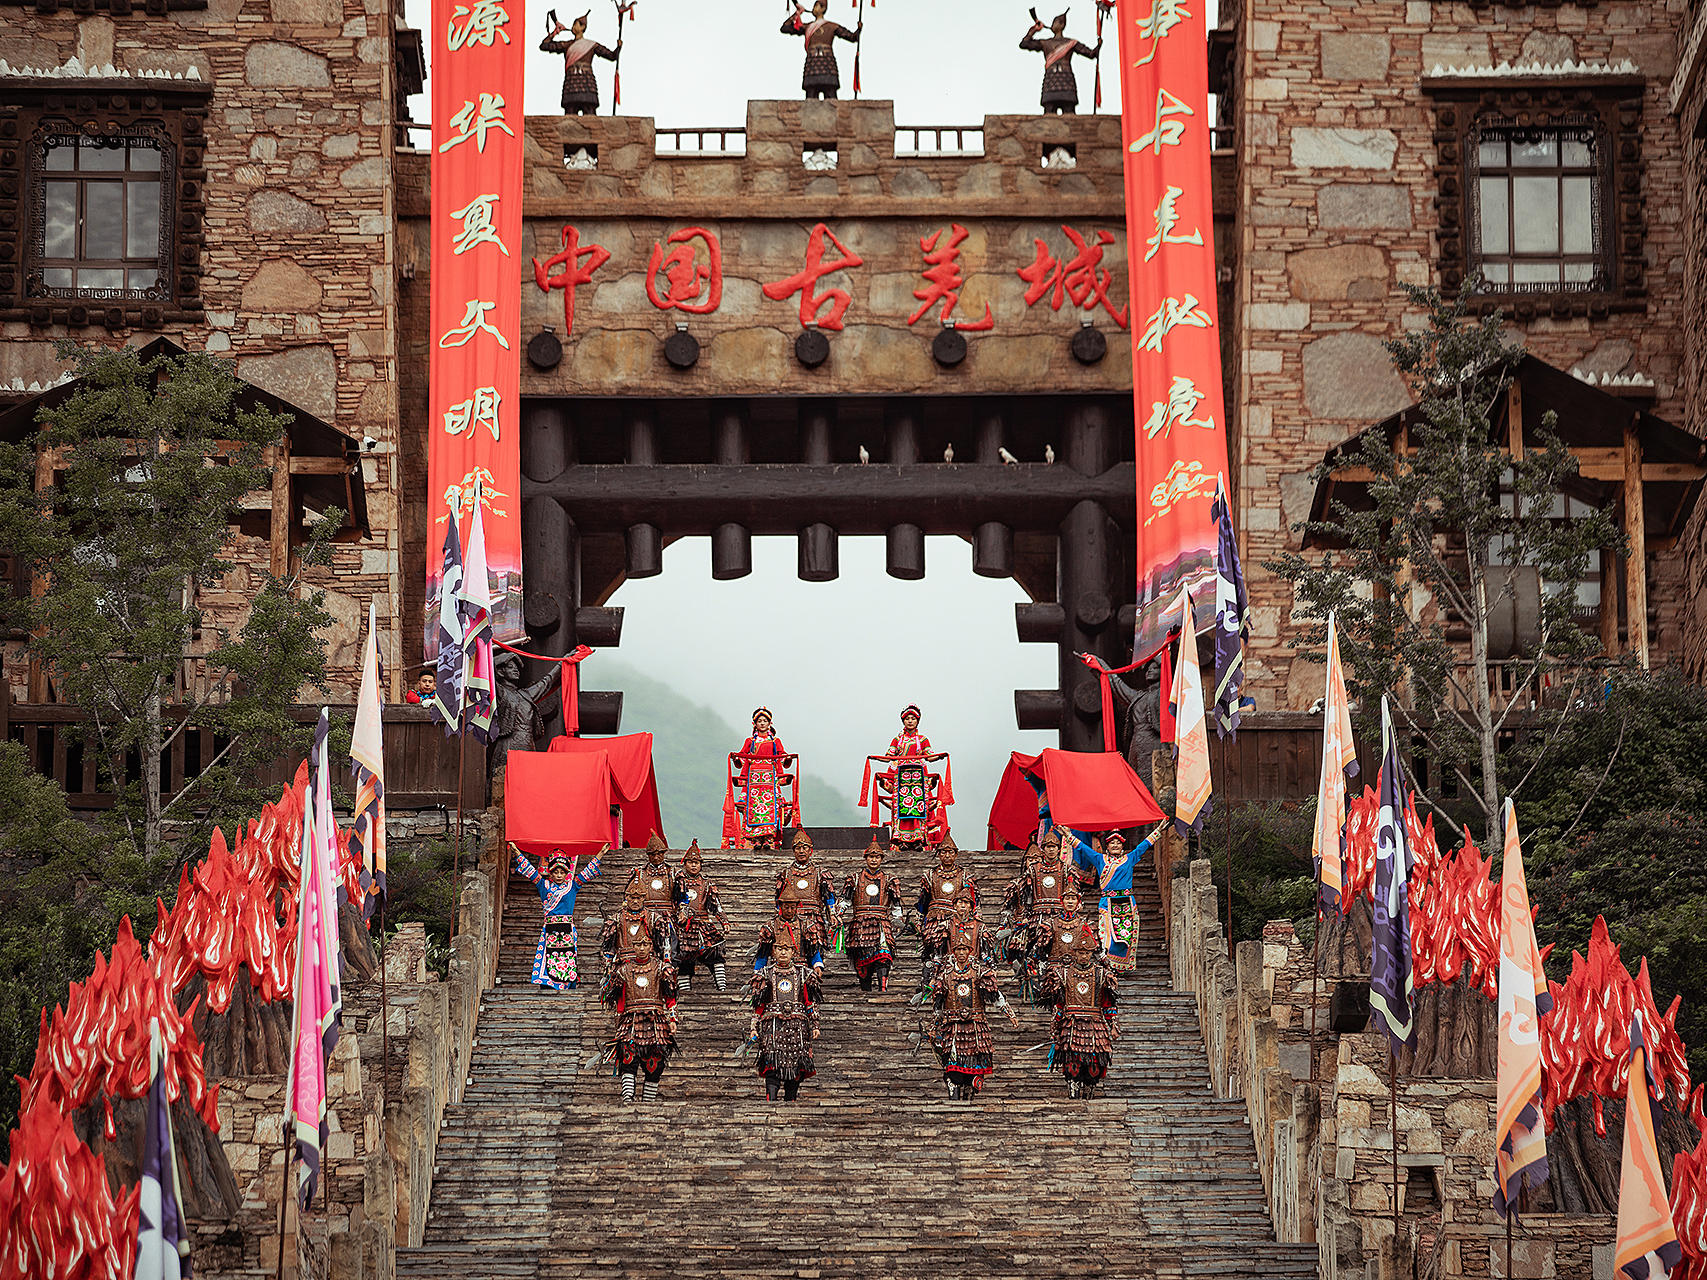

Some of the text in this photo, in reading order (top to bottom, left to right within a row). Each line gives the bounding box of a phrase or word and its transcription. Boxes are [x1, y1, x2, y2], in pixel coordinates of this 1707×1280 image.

[532, 223, 1129, 336] 中国古羌城
